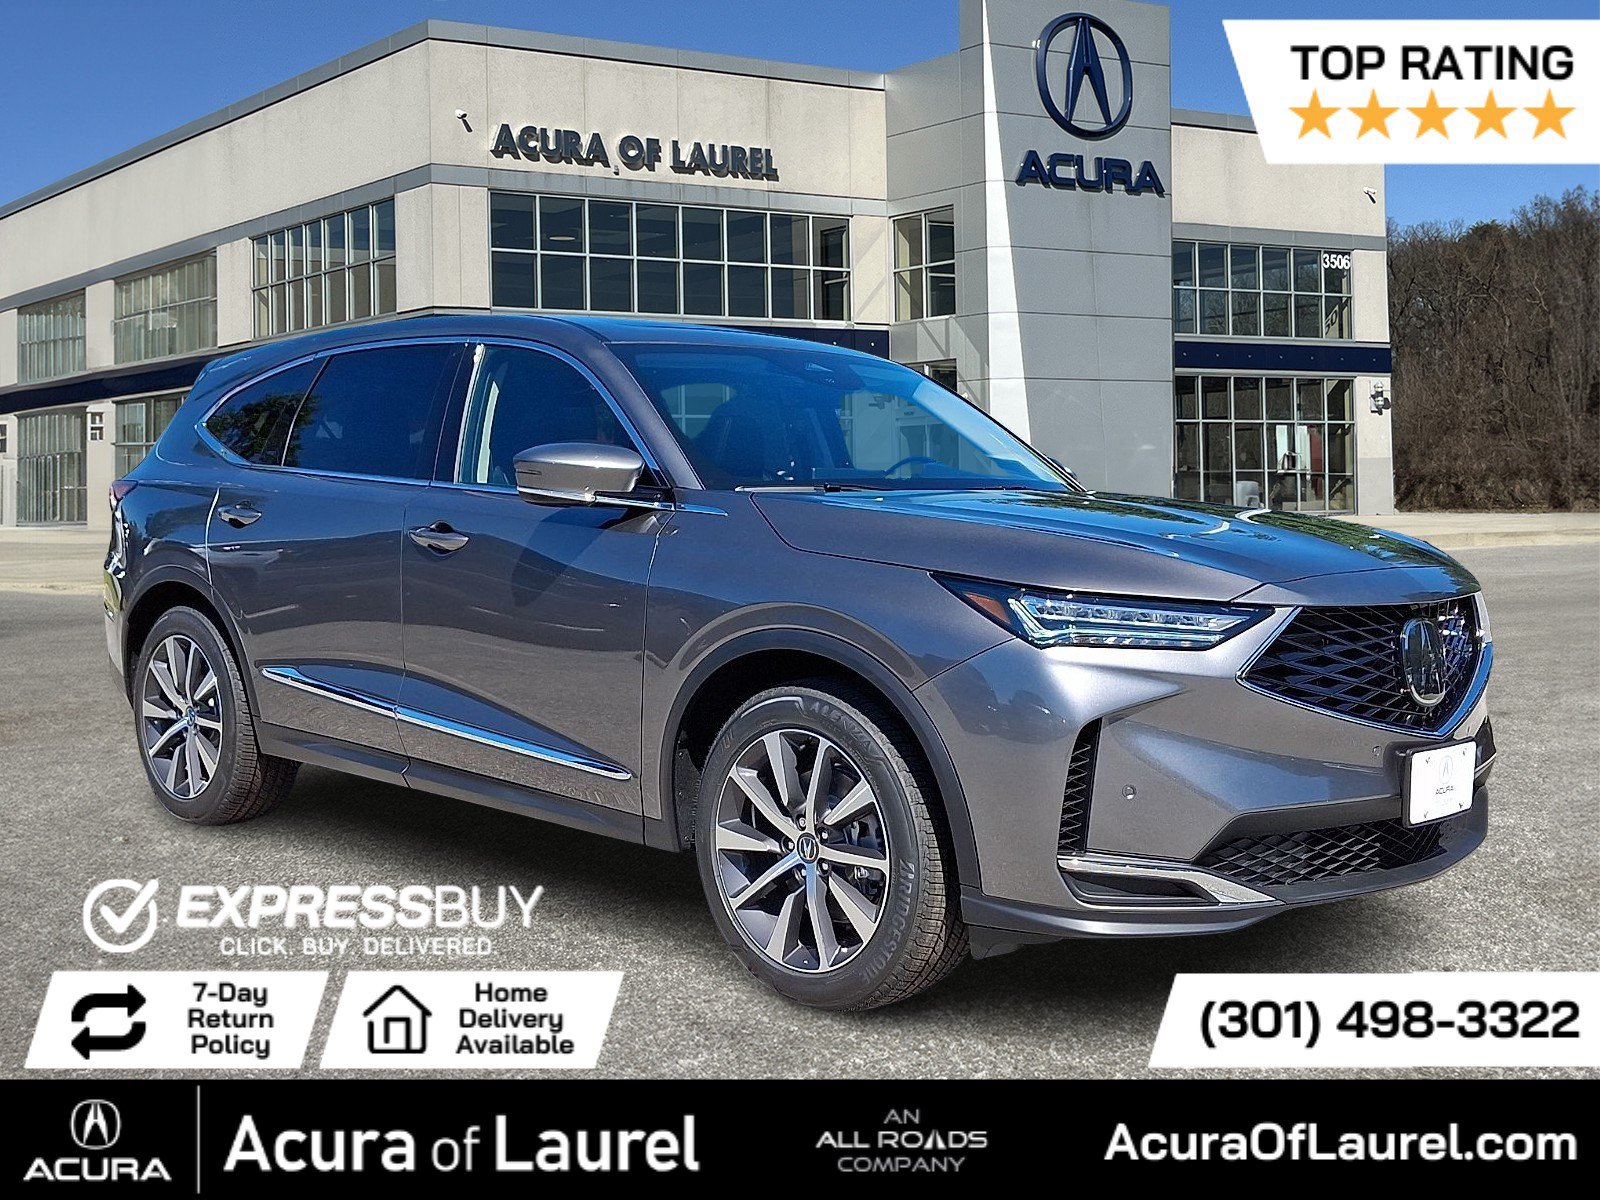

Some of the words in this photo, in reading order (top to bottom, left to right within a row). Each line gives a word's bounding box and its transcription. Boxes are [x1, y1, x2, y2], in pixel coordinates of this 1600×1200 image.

[490, 123, 611, 168] ACURA
[617, 134, 662, 172] OF
[669, 139, 780, 182] LAUREL
[1015, 149, 1166, 198] ACURA
[1322, 253, 1351, 270] 3506
